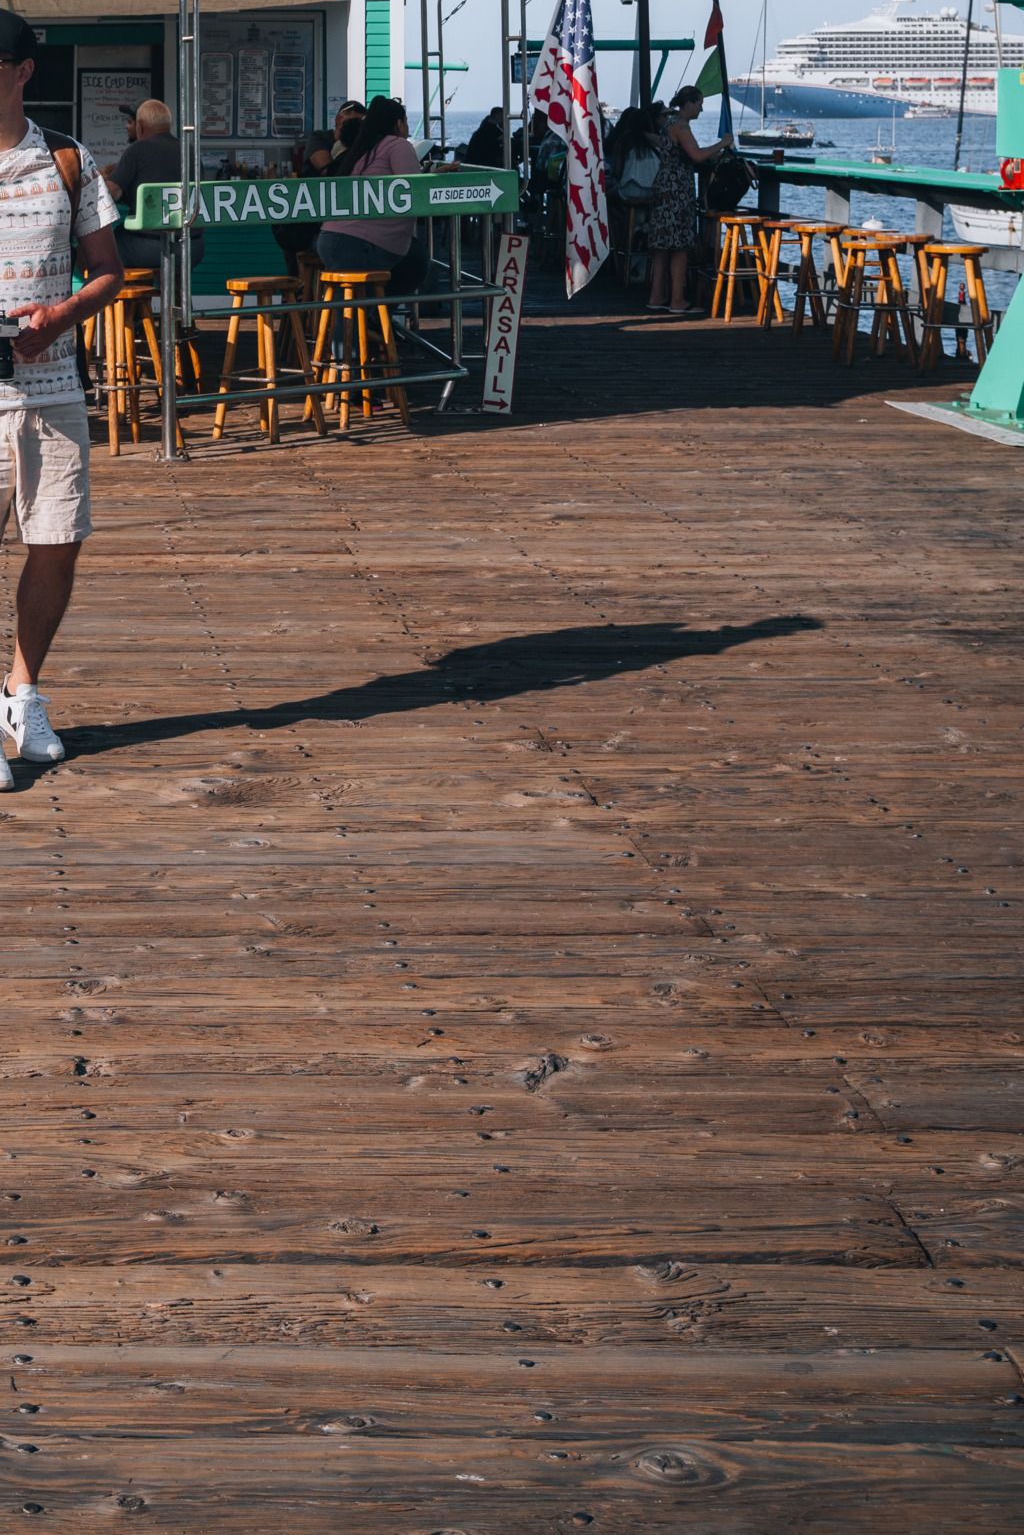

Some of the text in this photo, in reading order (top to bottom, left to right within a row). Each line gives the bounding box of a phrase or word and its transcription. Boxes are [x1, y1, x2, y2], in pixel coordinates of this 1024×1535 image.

[162, 178, 413, 225] PARASAILING
[432, 188, 492, 201] AT SIDE DOOR
[491, 236, 524, 394] PARASAIL
